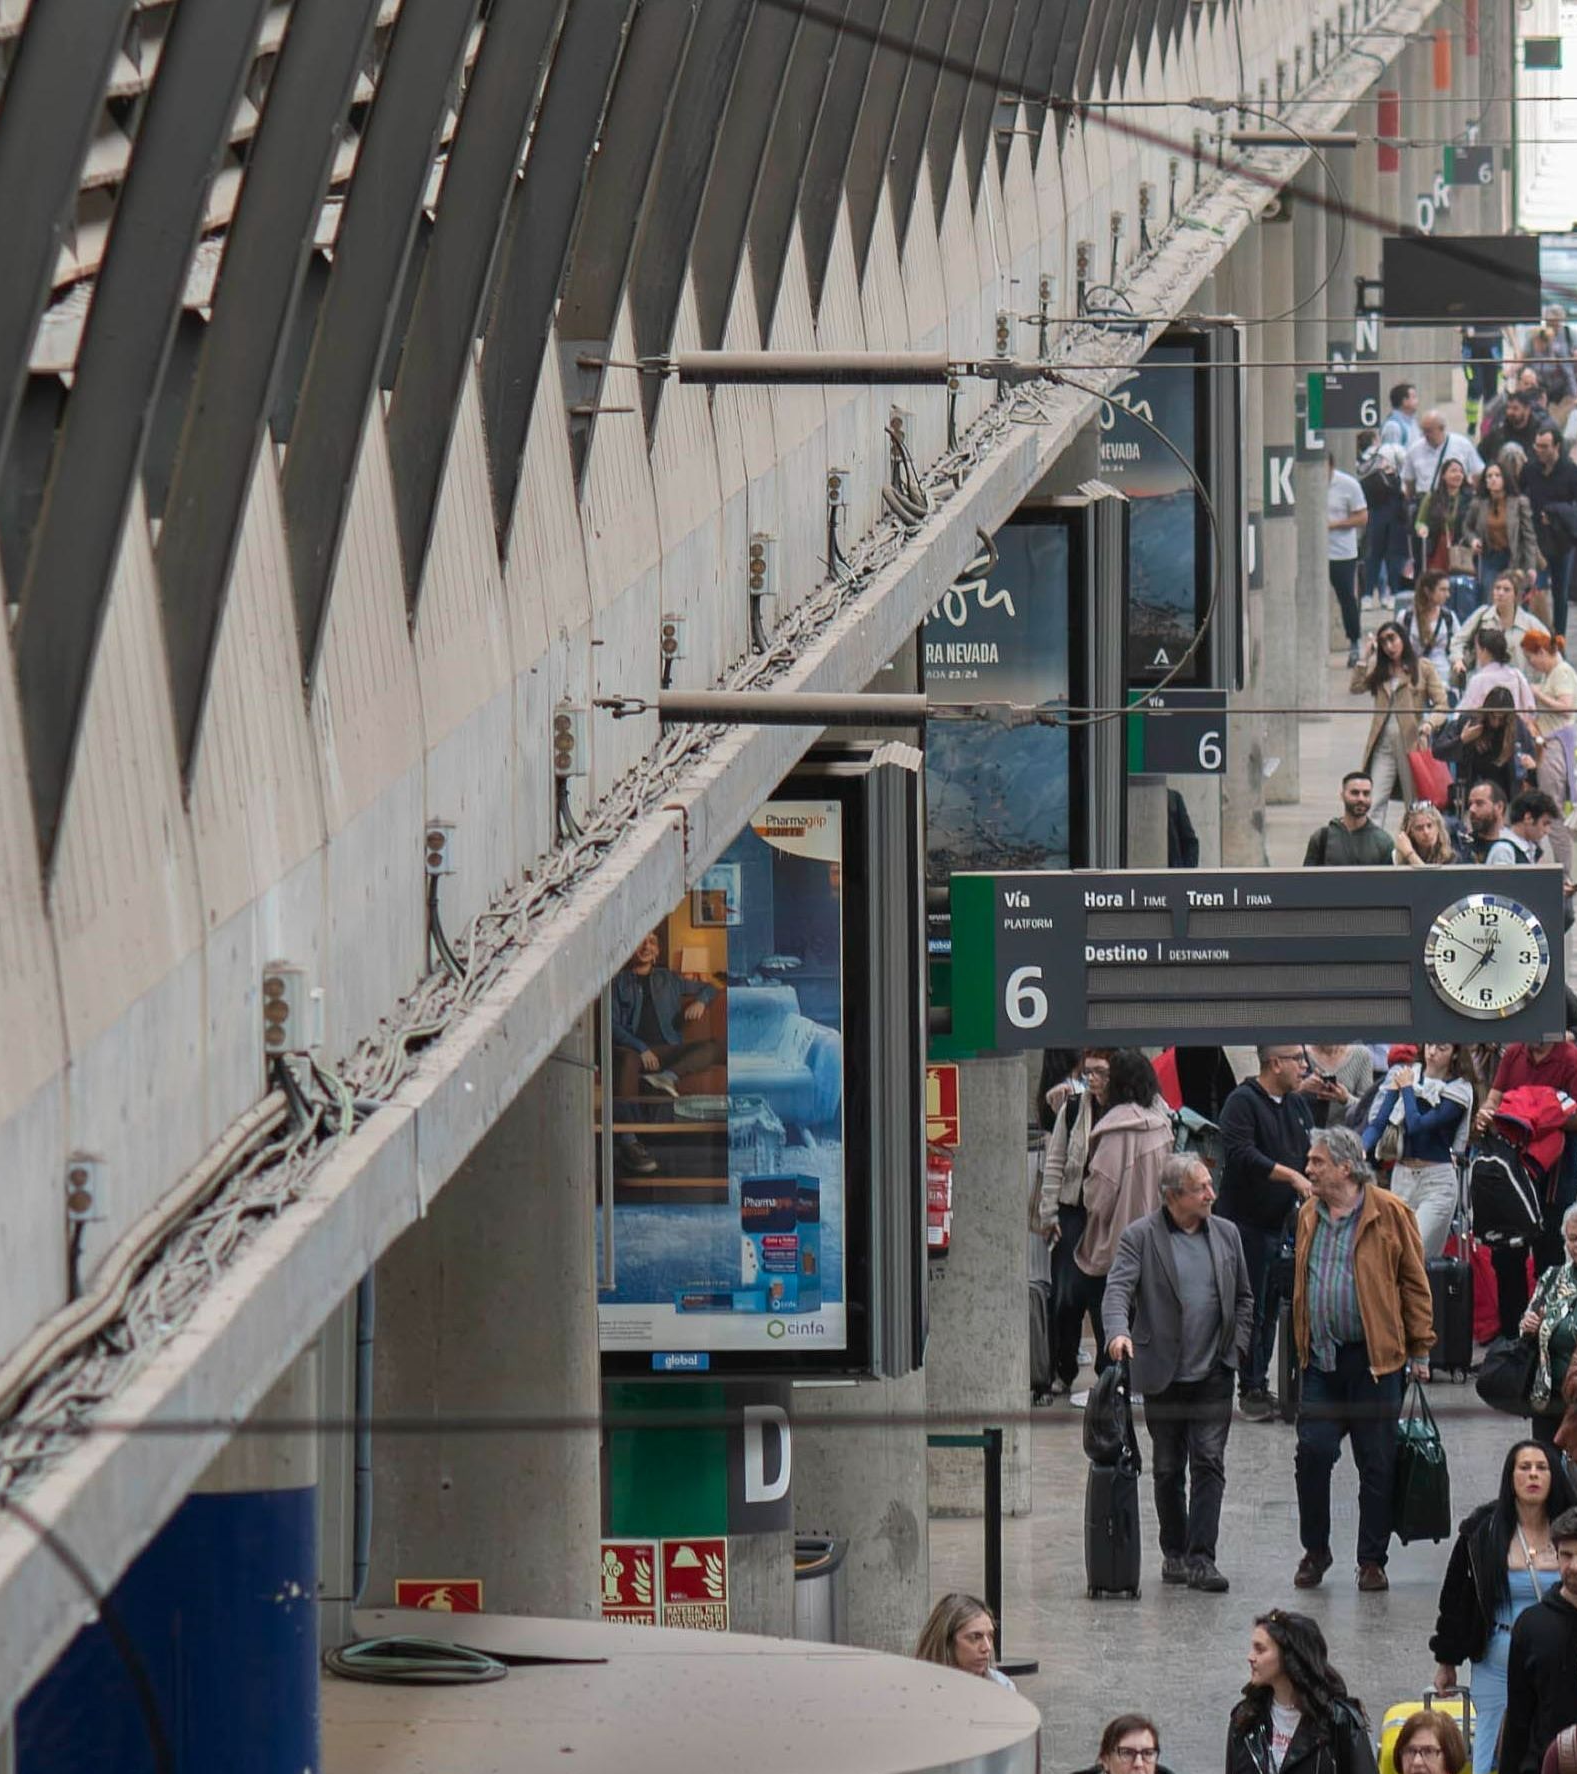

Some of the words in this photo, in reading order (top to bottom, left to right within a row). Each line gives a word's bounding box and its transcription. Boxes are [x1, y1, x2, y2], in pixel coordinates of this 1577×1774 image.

[1478, 162, 1492, 184] 6
[1357, 313, 1379, 352] N
[1361, 399, 1378, 427] 6
[1269, 457, 1295, 505] K
[946, 643, 999, 664] NEVADA
[1198, 731, 1222, 769] 6
[765, 814, 827, 829] Pharmagrip
[1004, 890, 1031, 908] Vía
[1083, 891, 1124, 908] Hora
[1143, 896, 1167, 907] TIME
[1186, 890, 1224, 907] Tren
[1004, 917, 1053, 929] PLATFORM
[1478, 913, 1499, 927] 12
[1084, 944, 1148, 962] Destino
[1169, 949, 1230, 961] DESTINATION
[1443, 950, 1456, 963] 9
[1519, 951, 1531, 964] 3
[1004, 965, 1049, 1029] 6
[1480, 988, 1493, 1002] 6
[664, 1353, 699, 1370] global
[743, 1405, 792, 1503] D
